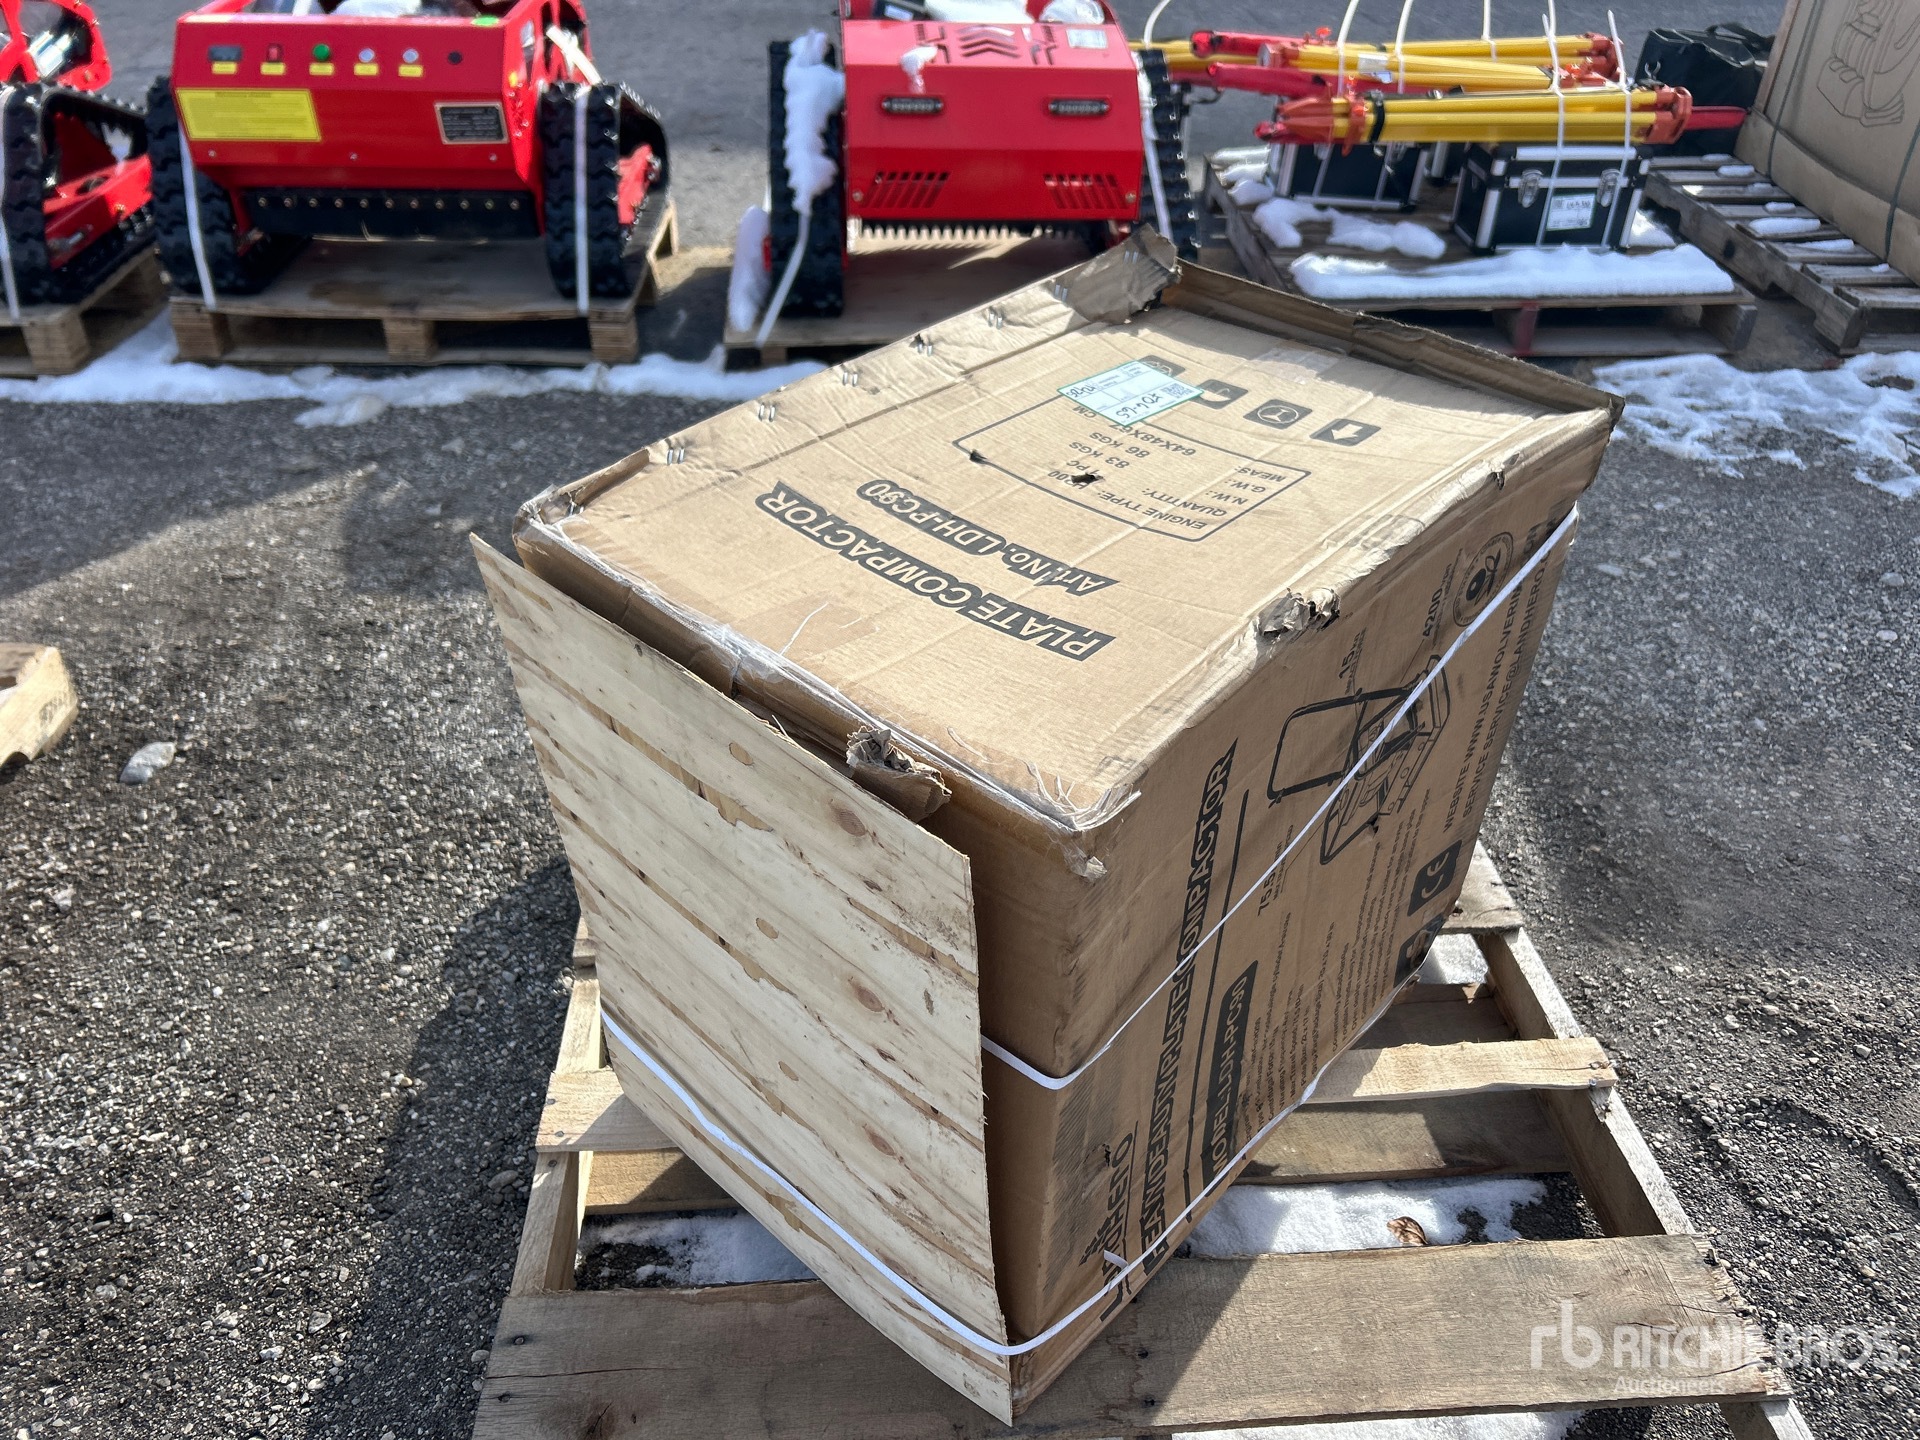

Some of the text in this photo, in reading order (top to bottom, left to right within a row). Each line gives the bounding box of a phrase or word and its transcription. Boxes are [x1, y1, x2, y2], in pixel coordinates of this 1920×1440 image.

[1071, 405, 1099, 417] CM
[1066, 441, 1105, 457] KGS
[1086, 432, 1124, 447] KGS
[1102, 456, 1131, 468] 83
[1122, 446, 1151, 458] 86
[1065, 459, 1091, 470] PC
[1232, 465, 1287, 482] MEAS:
[1094, 490, 1145, 511] TYPE:
[1139, 487, 1229, 518] QUANTITY:
[858, 481, 1005, 553] LDH-PC90
[1140, 507, 1207, 531] ENGINE
[758, 490, 1103, 657] PLATE COMPACTOR
[1462, 751, 1491, 818] SERVICE
[1443, 762, 1469, 833] WEBSITE
[1161, 968, 1191, 1076] PLATE
[1176, 758, 1229, 984] COMPACTOR
